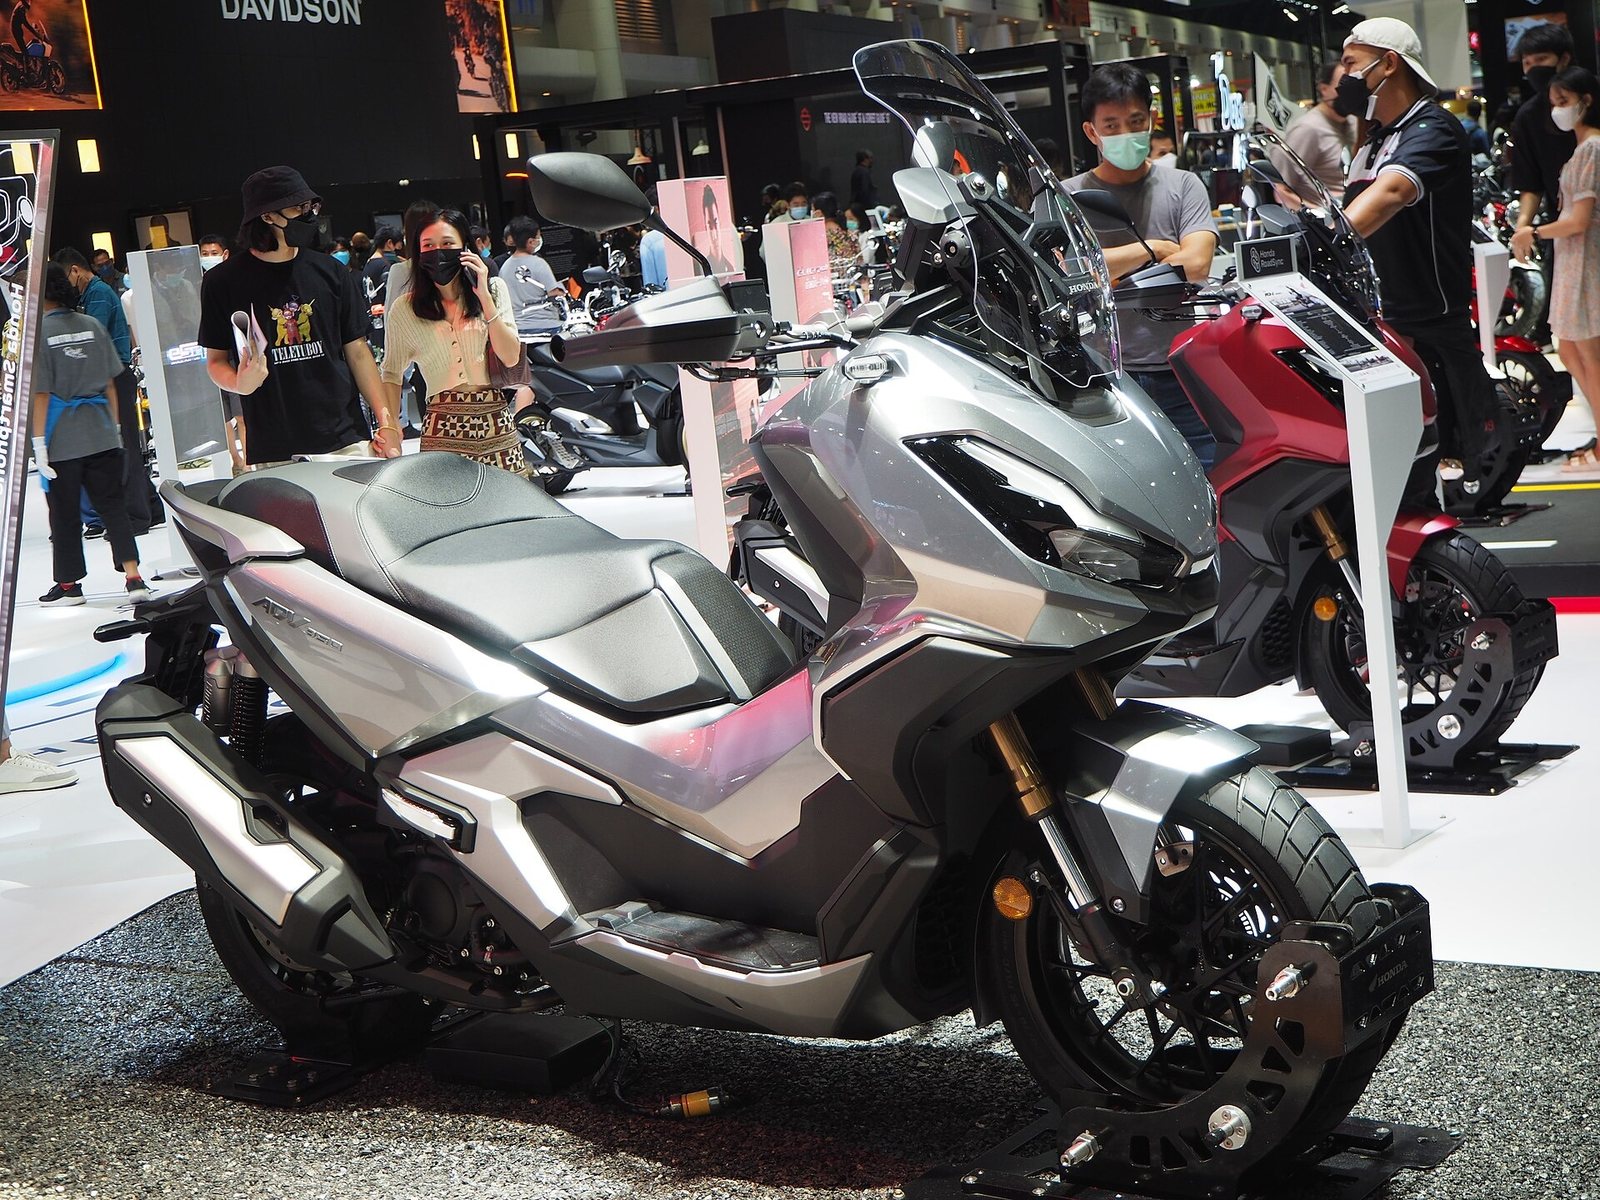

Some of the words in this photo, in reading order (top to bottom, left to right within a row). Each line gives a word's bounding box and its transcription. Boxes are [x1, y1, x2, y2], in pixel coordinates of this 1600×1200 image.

[221, 0, 361, 25] DAVIDSON
[1259, 249, 1276, 258] Honda
[271, 340, 323, 361] TELETUBOY
[252, 596, 311, 629] ADV
[1377, 960, 1408, 987] HONDA
